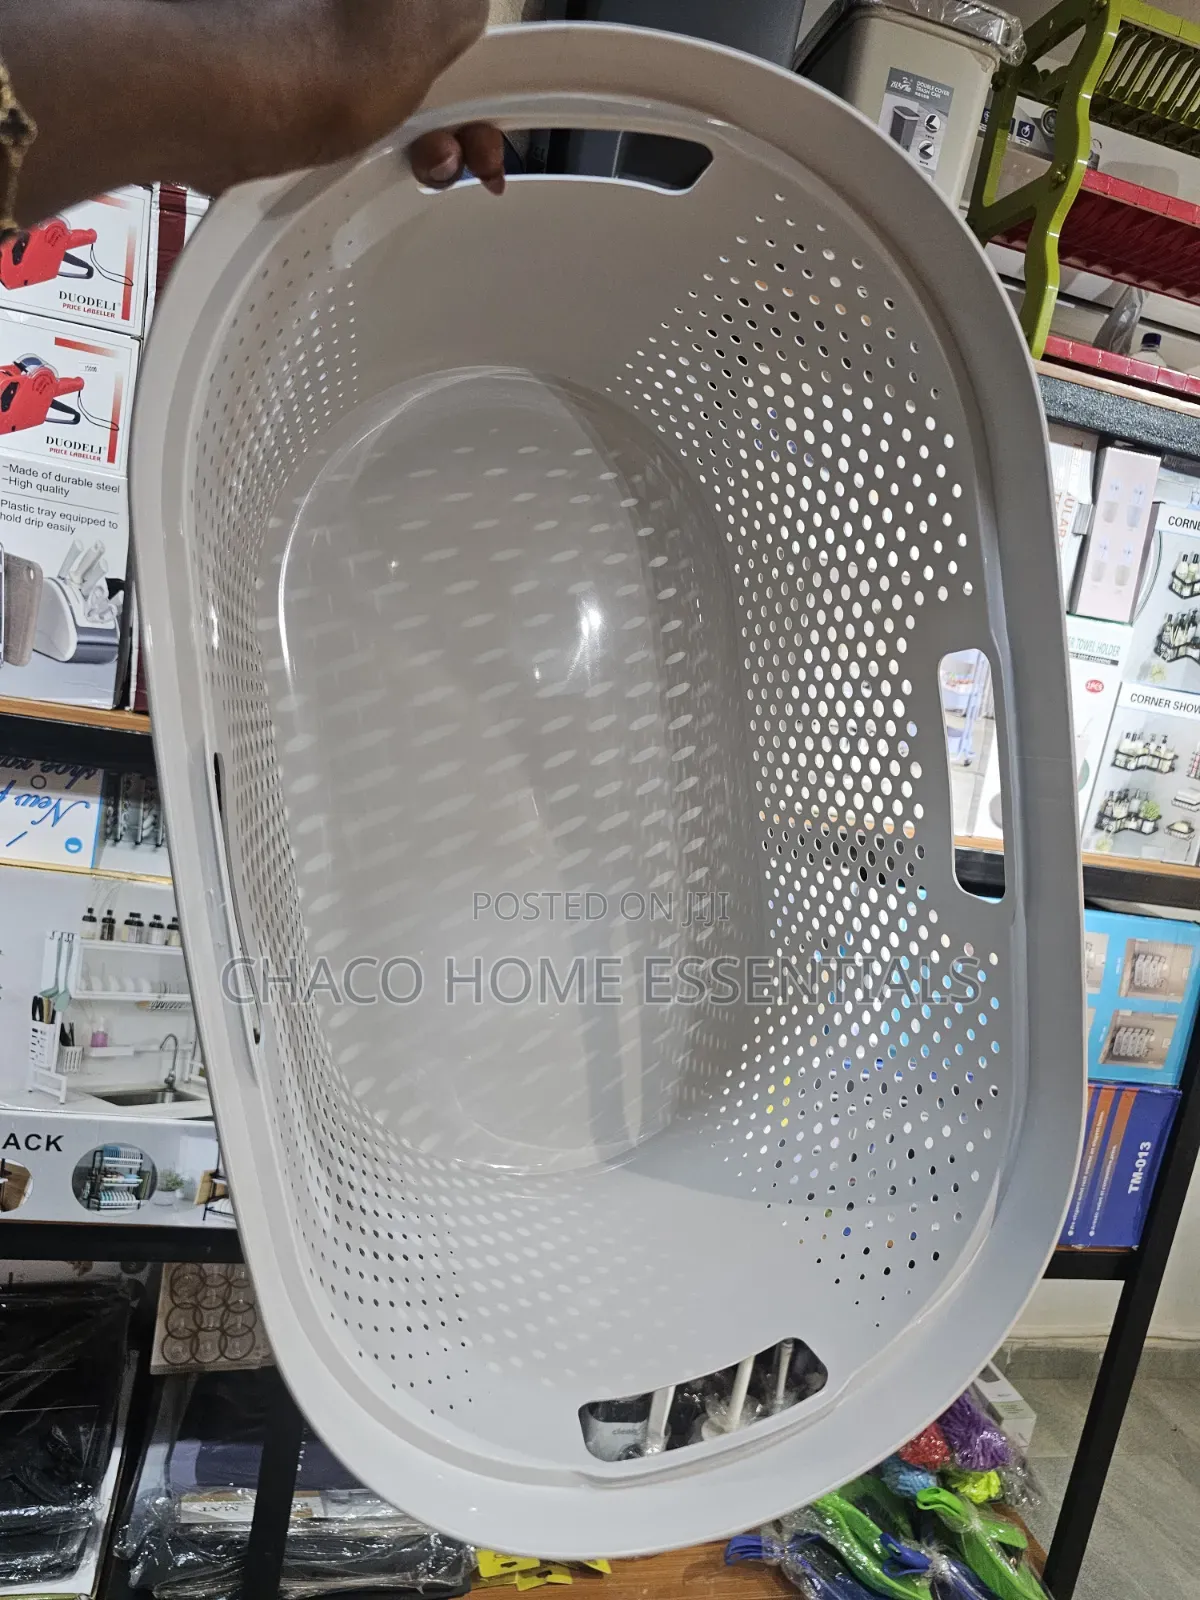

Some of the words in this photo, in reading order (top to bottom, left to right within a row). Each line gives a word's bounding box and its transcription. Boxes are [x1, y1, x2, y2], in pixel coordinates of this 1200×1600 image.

[59, 290, 116, 311] DUODELI
[62, 302, 82, 312] PRICE
[83, 307, 115, 318] LABELLER
[46, 435, 102, 455] DUODELI
[49, 447, 68, 456] PRICE
[69, 451, 101, 462] LABELLER
[35, 481, 70, 498] quality
[41, 471, 53, 480] of
[54, 473, 93, 489] durable
[95, 482, 121, 494] steel
[0, 499, 35, 514] Plastic
[37, 506, 57, 519] tray
[59, 512, 106, 528] equipped
[108, 519, 119, 530] to
[0, 511, 22, 524] hold
[24, 516, 44, 529] drip
[46, 521, 76, 536] easily
[1130, 692, 1171, 709] CORNER
[14, 793, 90, 828] New
[1, 1132, 65, 1152] ACK
[1127, 1141, 1152, 1195] TM-013
